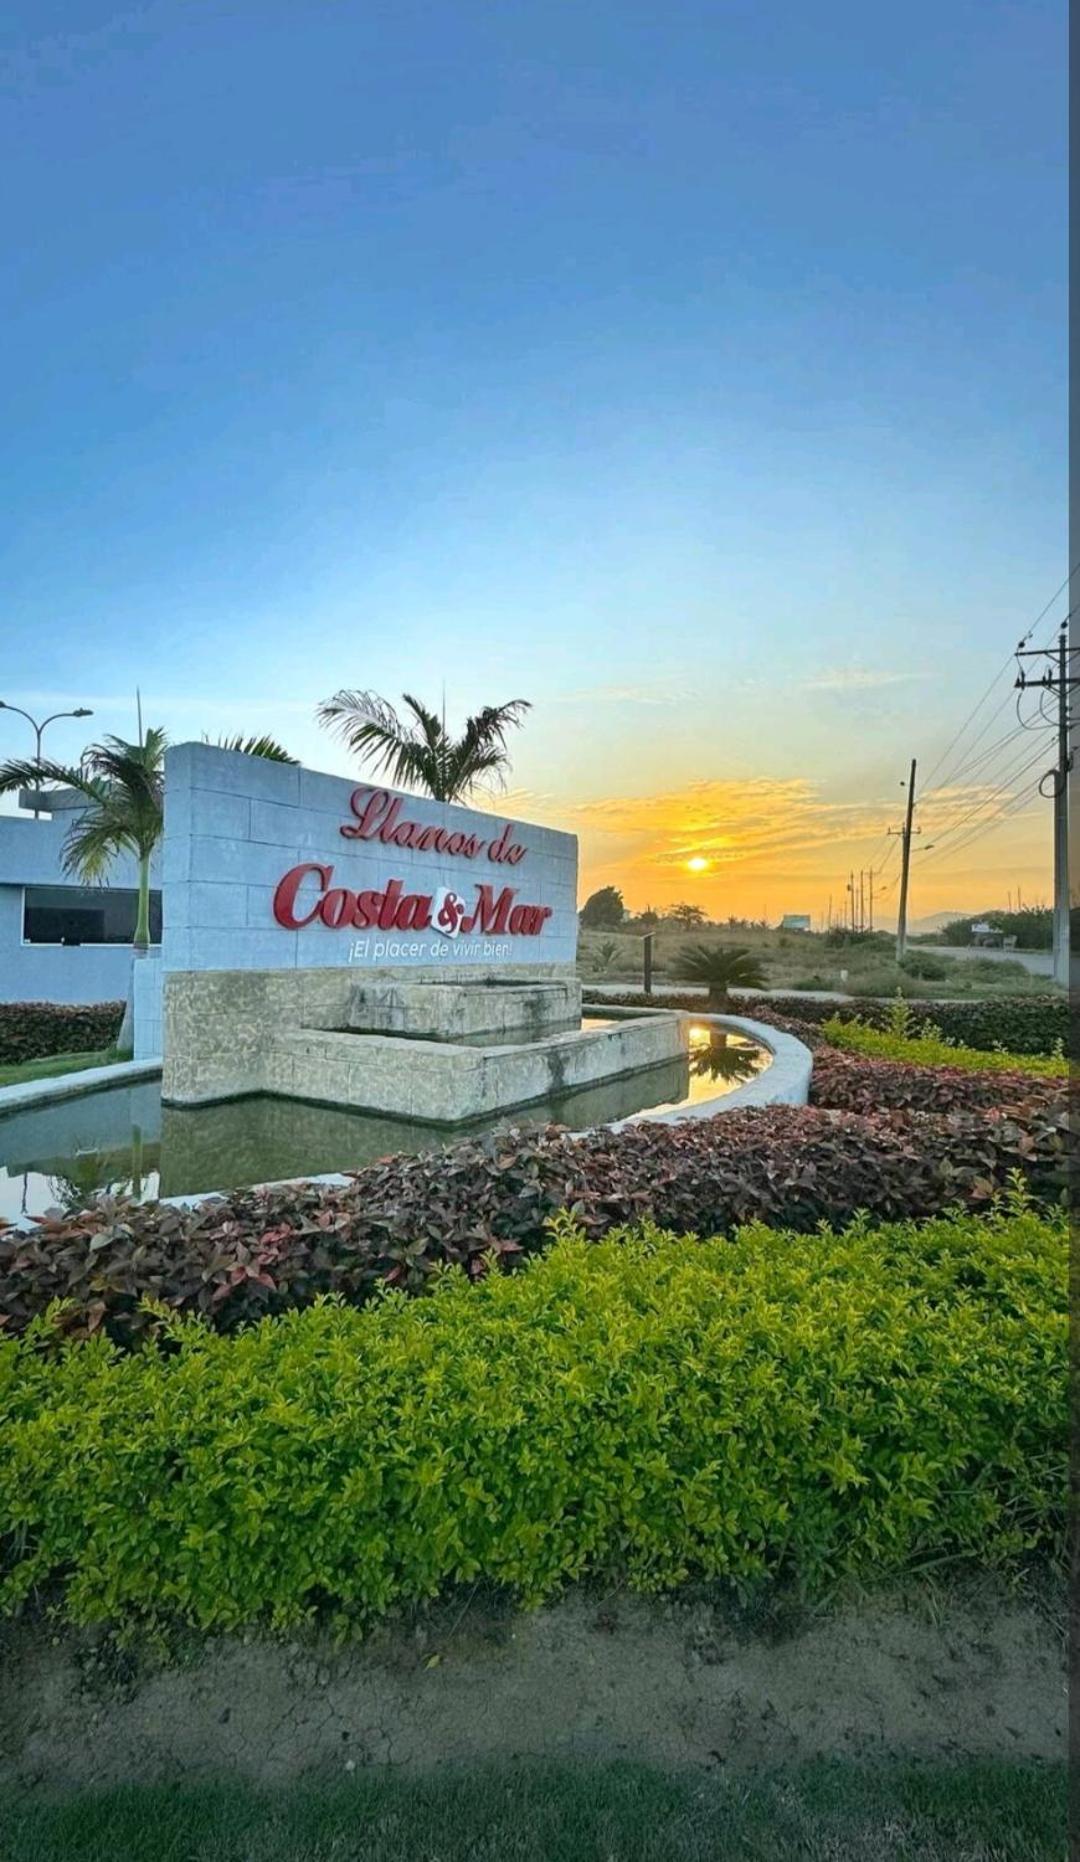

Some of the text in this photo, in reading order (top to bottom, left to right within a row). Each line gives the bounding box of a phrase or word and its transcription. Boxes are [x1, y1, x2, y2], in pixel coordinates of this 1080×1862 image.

[340, 787, 528, 865] Llanos de
[274, 863, 552, 935] Costa & Mar
[349, 938, 370, 963] ¡El
[373, 939, 427, 961] placer
[430, 939, 449, 958] de
[453, 939, 481, 958] vivir
